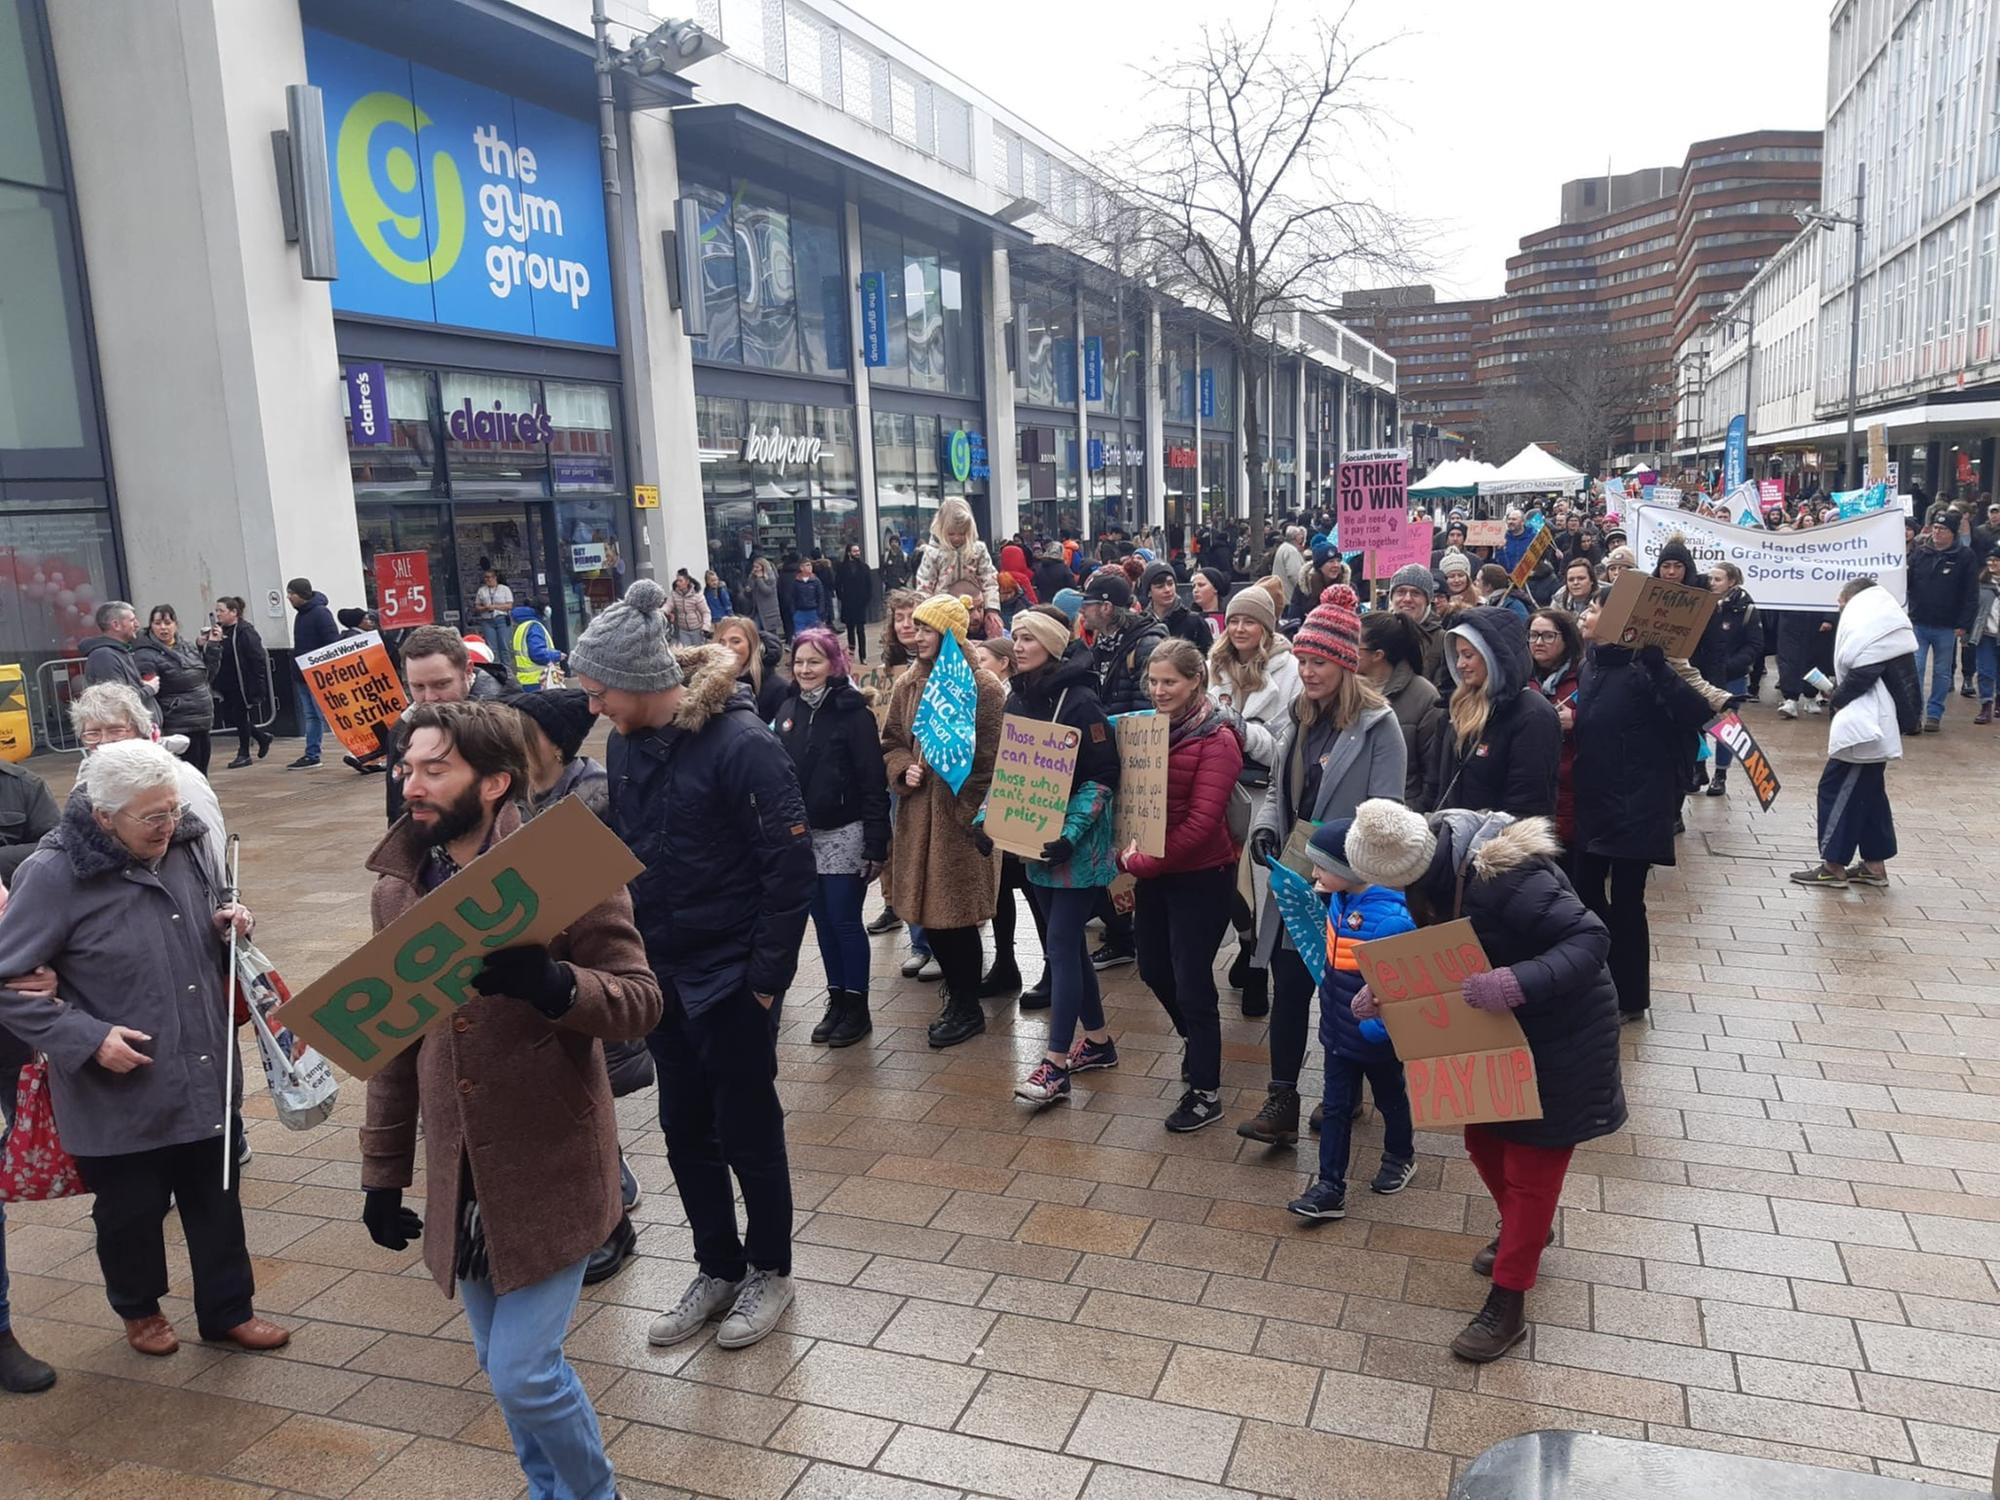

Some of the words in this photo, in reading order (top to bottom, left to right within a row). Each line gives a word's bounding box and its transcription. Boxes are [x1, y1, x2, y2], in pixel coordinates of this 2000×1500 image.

[473, 124, 537, 184] the
[478, 184, 564, 243] gym
[485, 244, 590, 310] group
[355, 371, 376, 437] claire's
[449, 397, 555, 444] claire's
[746, 423, 821, 477] bodycare
[1341, 463, 1403, 488] STRIKE
[1340, 488, 1363, 512] TO
[1369, 486, 1404, 510] WIN
[1351, 526, 1364, 536] pay
[1366, 524, 1381, 533] rise
[1357, 514, 1367, 524] all
[1368, 514, 1386, 523] need
[1344, 538, 1366, 549] Strike
[1368, 536, 1399, 549] together
[391, 557, 413, 578] SALE
[1747, 564, 1805, 582] Sports
[384, 588, 399, 617] 5
[407, 585, 427, 613] £5
[307, 649, 339, 666] Socialist
[339, 639, 370, 654] Worker
[312, 655, 370, 691] Defend
[323, 690, 349, 712] the
[351, 672, 394, 703] right
[334, 713, 353, 731] to
[353, 696, 402, 726] strike
[1005, 722, 1035, 746] Those
[1042, 731, 1067, 751] who
[1033, 751, 1075, 777] teach!
[1744, 750, 1776, 802] PAY
[995, 768, 1026, 786] Those
[1030, 776, 1060, 794] who
[1004, 805, 1049, 832] policy
[1407, 1054, 1476, 1122] PAY
[1485, 1048, 1533, 1118] UP
